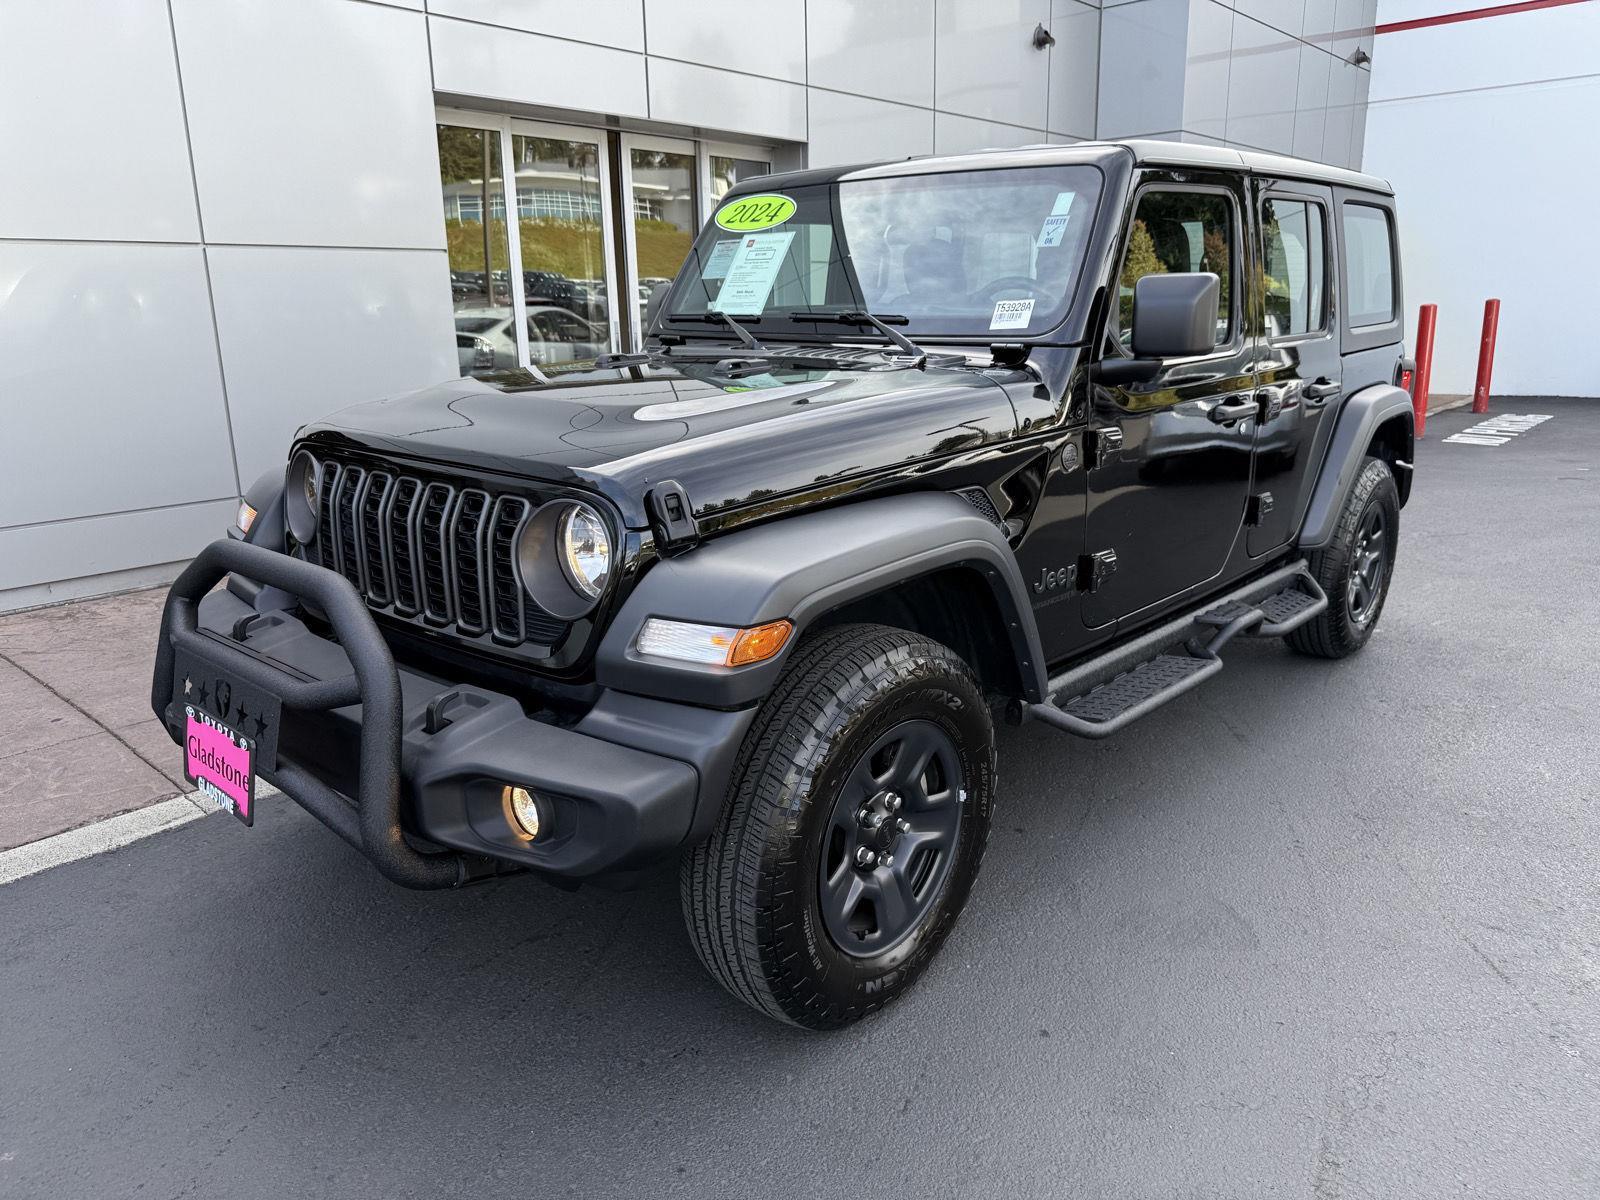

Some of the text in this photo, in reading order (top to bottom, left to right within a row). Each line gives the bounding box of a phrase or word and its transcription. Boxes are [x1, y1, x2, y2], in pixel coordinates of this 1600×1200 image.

[725, 201, 787, 225] 2024
[996, 301, 1032, 313] T53928A
[1034, 563, 1077, 593] Jeep
[199, 711, 235, 742] TOYOTA
[188, 735, 249, 792] Gladstone
[197, 776, 235, 814] GLADSTONE
